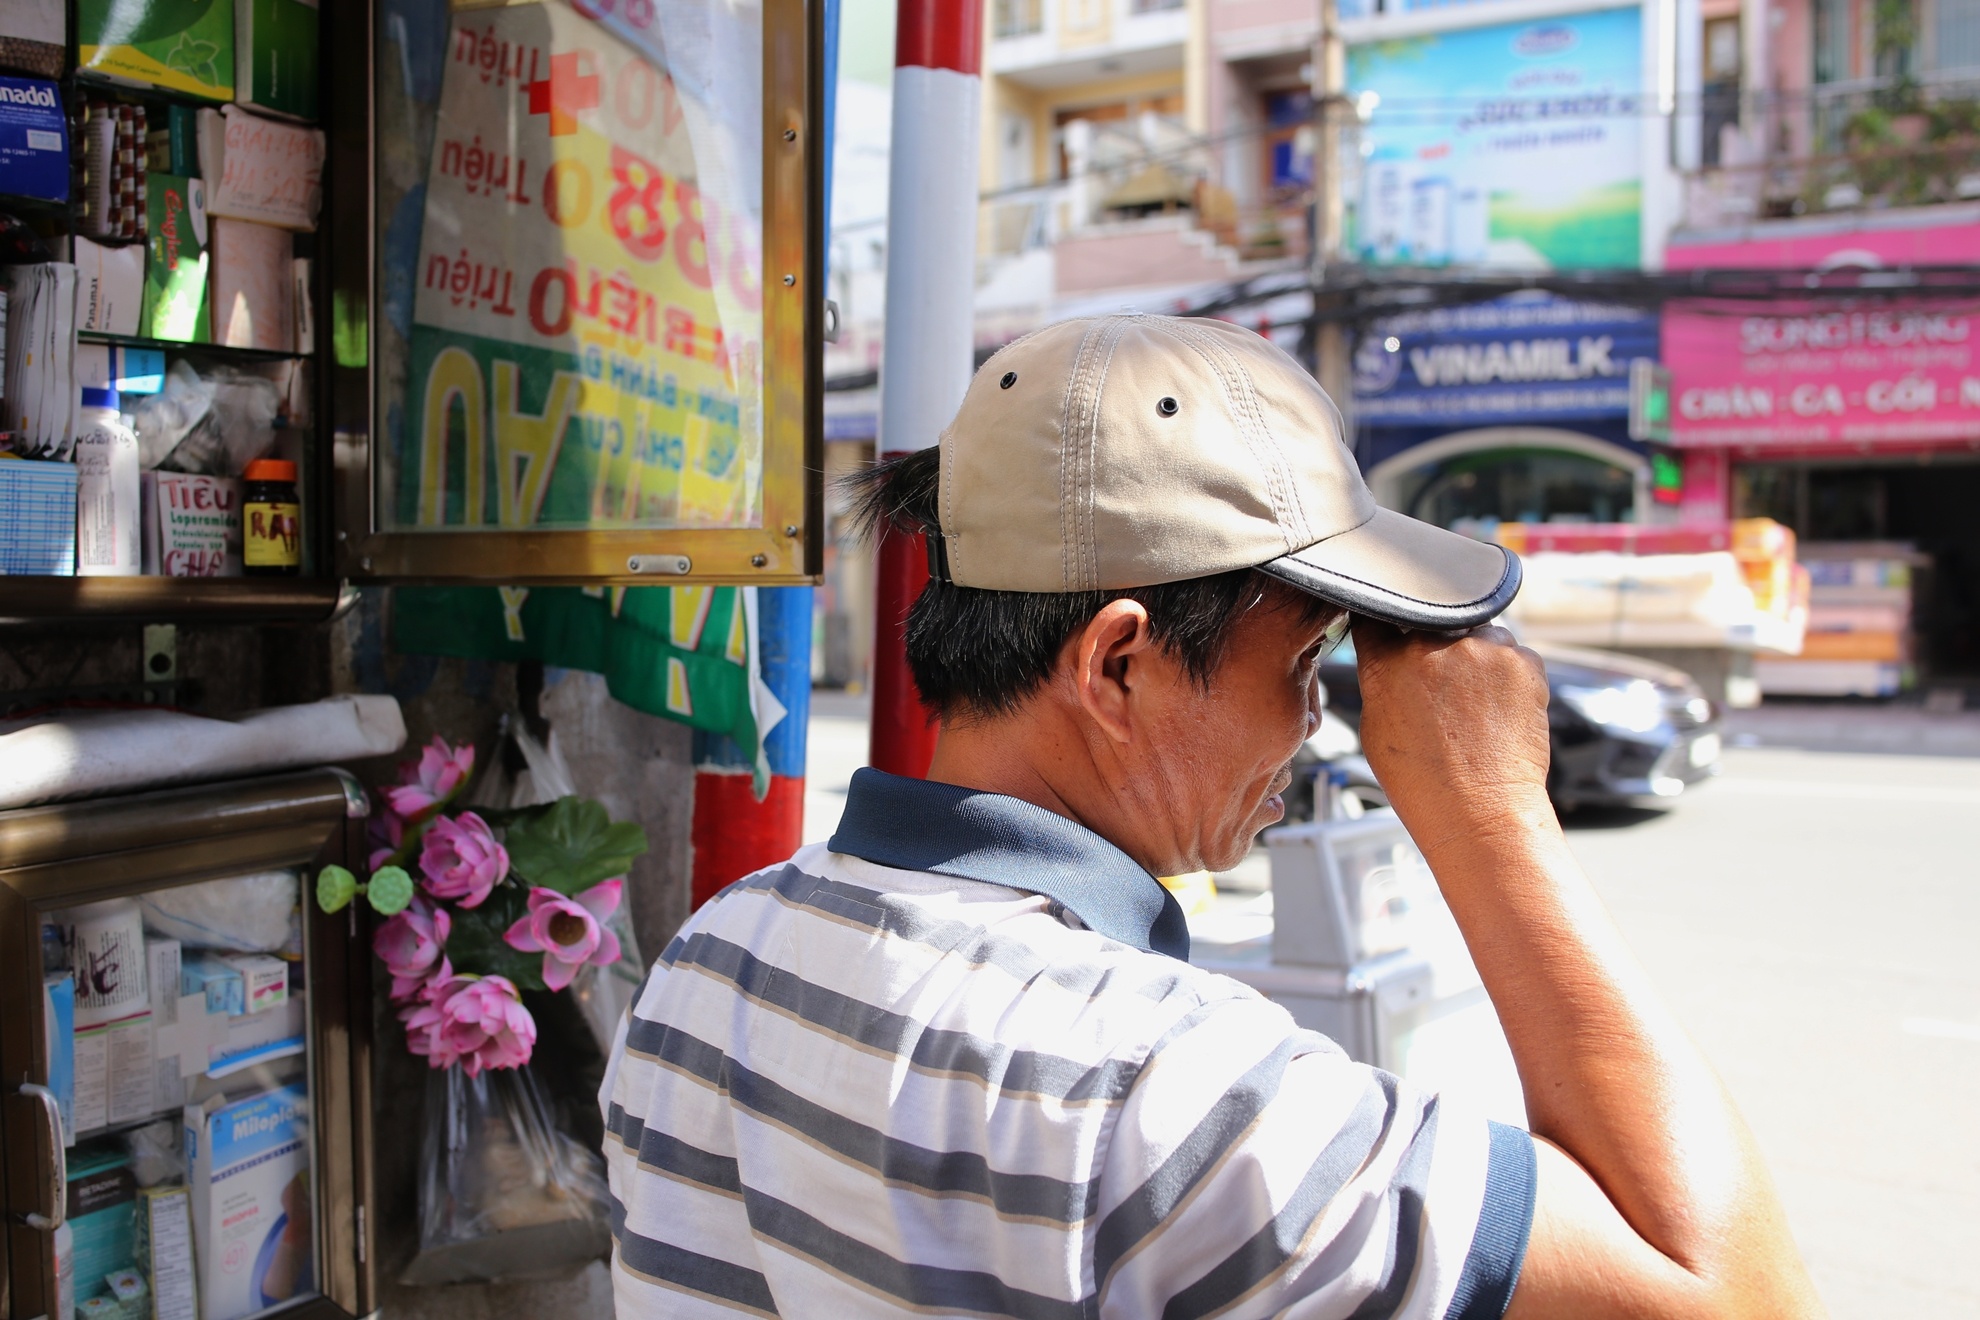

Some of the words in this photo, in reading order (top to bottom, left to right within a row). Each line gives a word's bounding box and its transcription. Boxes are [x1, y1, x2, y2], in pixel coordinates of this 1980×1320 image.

[0, 85, 56, 107] nadol
[441, 136, 531, 205] Triệu
[85, 277, 98, 330] Panamax
[426, 249, 515, 316] Triệu
[1410, 334, 1614, 387] VINAMILK
[1790, 382, 1845, 418] GA
[160, 478, 235, 510] TIÊU
